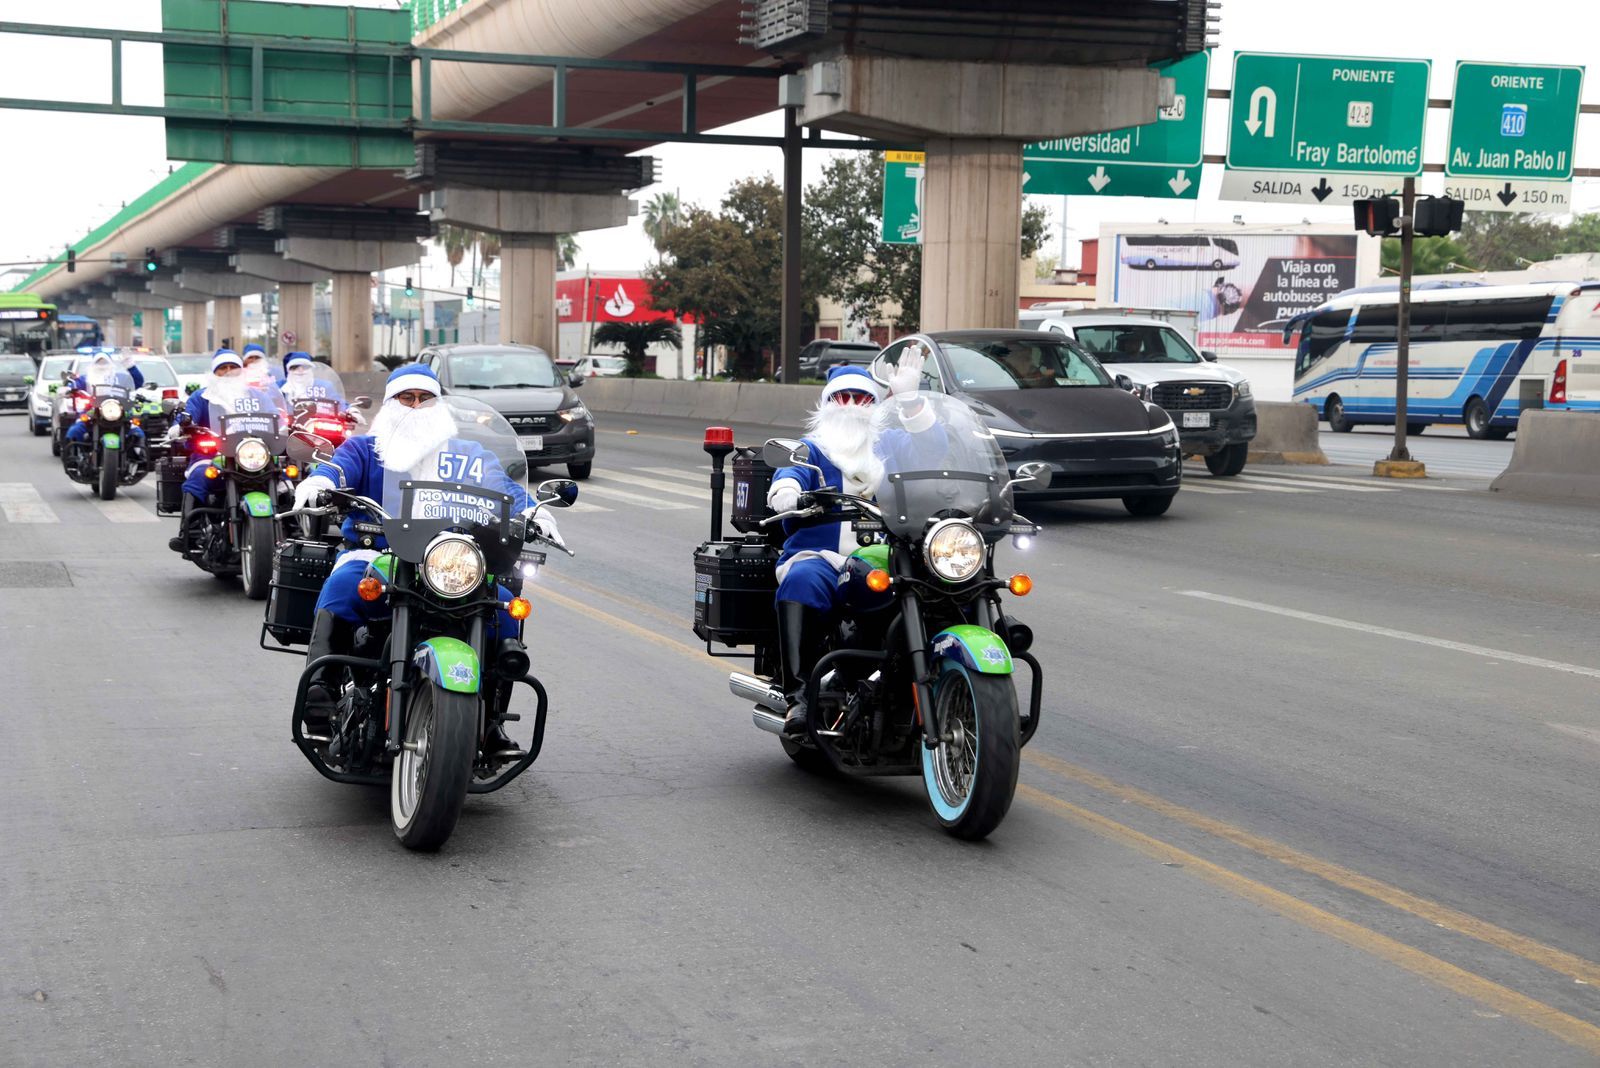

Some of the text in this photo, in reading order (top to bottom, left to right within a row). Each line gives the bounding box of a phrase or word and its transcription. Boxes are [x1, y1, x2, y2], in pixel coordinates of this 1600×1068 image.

[1331, 68, 1395, 84] PONIENTE
[1490, 75, 1545, 90] ORIENTE
[1503, 114, 1525, 134] 410
[1296, 141, 1418, 167] Fray Bartolomé
[1451, 147, 1567, 171] Av. Juan Pablo II
[1252, 181, 1302, 196] SALIDA
[1342, 184, 1369, 198] 150
[1444, 187, 1568, 205] SALIDA 150 m.
[1281, 260, 1336, 276] Viaja con
[1277, 274, 1340, 289] la línea de
[1262, 290, 1324, 302] autobuses
[306, 386, 326, 398] 563
[234, 398, 260, 412] 565
[509, 416, 547, 425] RAM
[437, 452, 484, 485] 574
[419, 490, 497, 511] MOVILIDAD
[736, 483, 750, 508] 557
